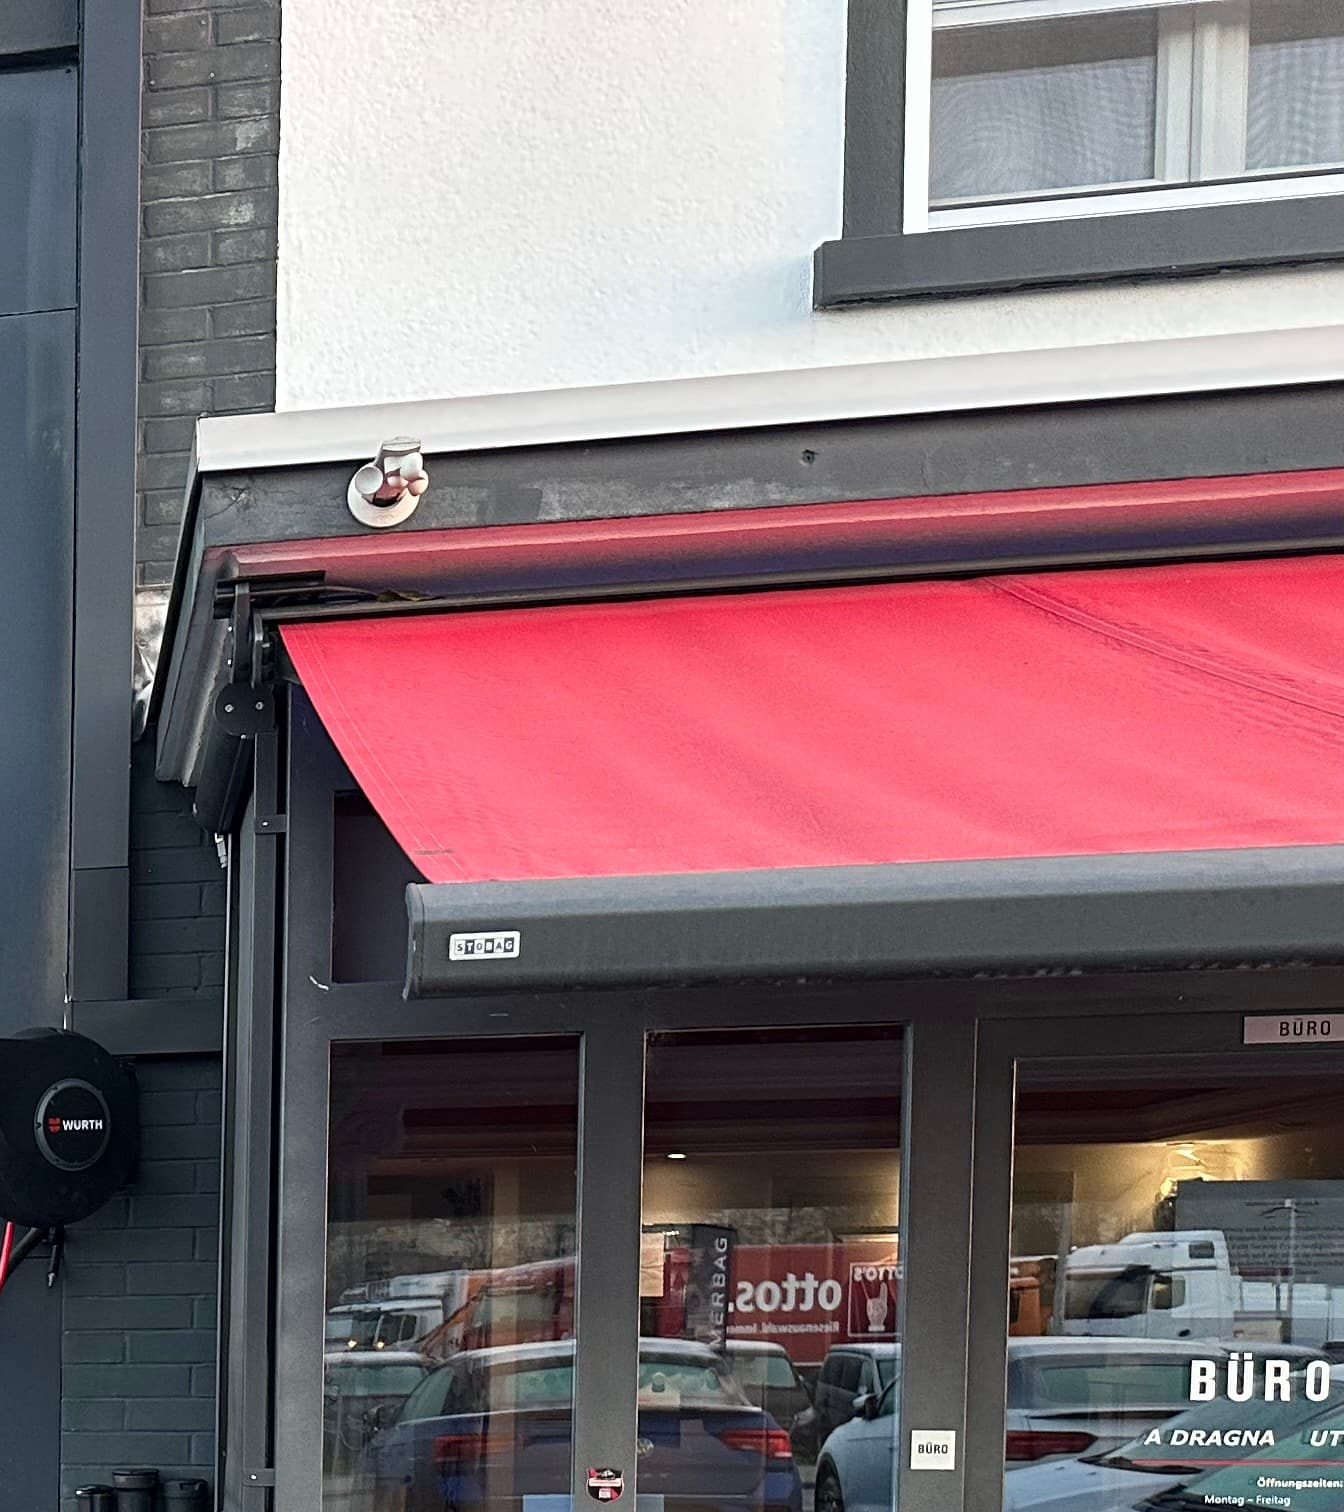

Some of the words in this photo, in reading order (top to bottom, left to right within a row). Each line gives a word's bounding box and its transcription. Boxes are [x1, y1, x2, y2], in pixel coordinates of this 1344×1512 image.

[1279, 1016, 1331, 1037] BÜRO
[1189, 1351, 1331, 1402] BÜRO
[1144, 1429, 1162, 1445] A
[1170, 1429, 1275, 1446] DRAGNA
[917, 1440, 949, 1455] BÜRO
[1257, 1476, 1343, 1490] Öffnungszeiten:
[1204, 1495, 1244, 1506] Montag
[1256, 1495, 1291, 1506] Freitag
